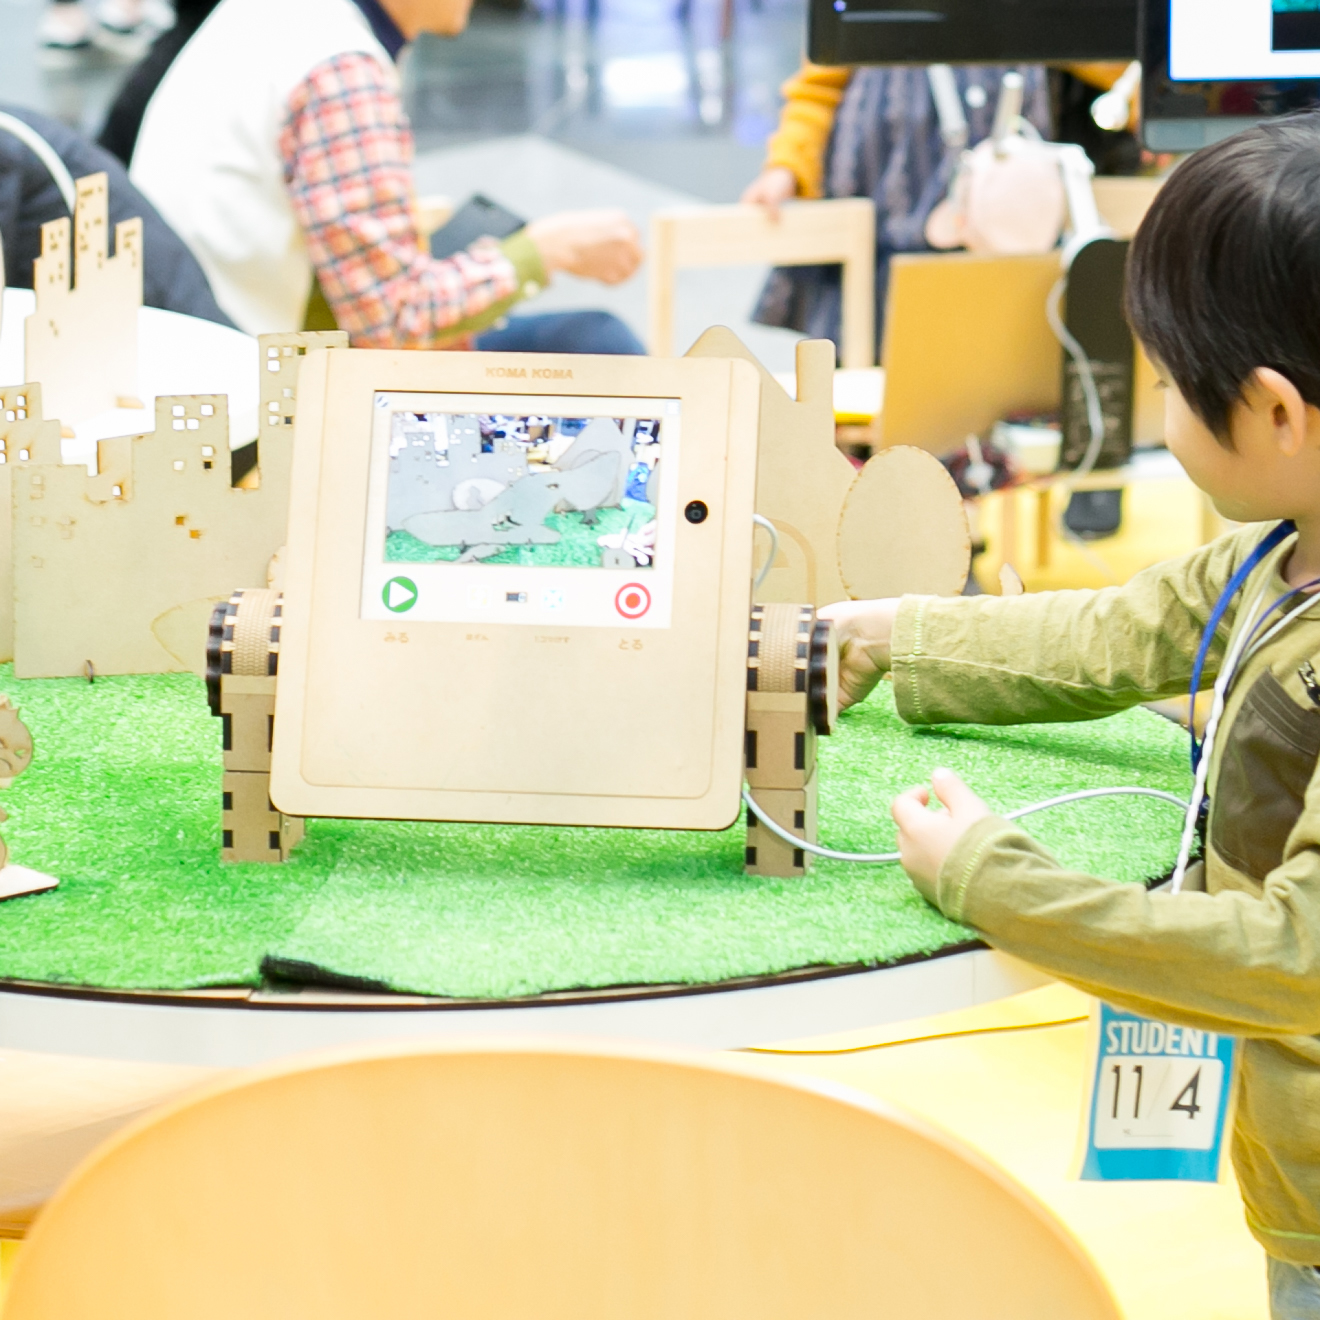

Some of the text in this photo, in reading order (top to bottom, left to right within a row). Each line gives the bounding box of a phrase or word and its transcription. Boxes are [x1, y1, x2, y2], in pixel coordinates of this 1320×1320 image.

[485, 367, 574, 380] KOMA KOMA
[383, 632, 410, 644] みる
[617, 638, 644, 651] とる
[1106, 1021, 1218, 1056] STUDENT
